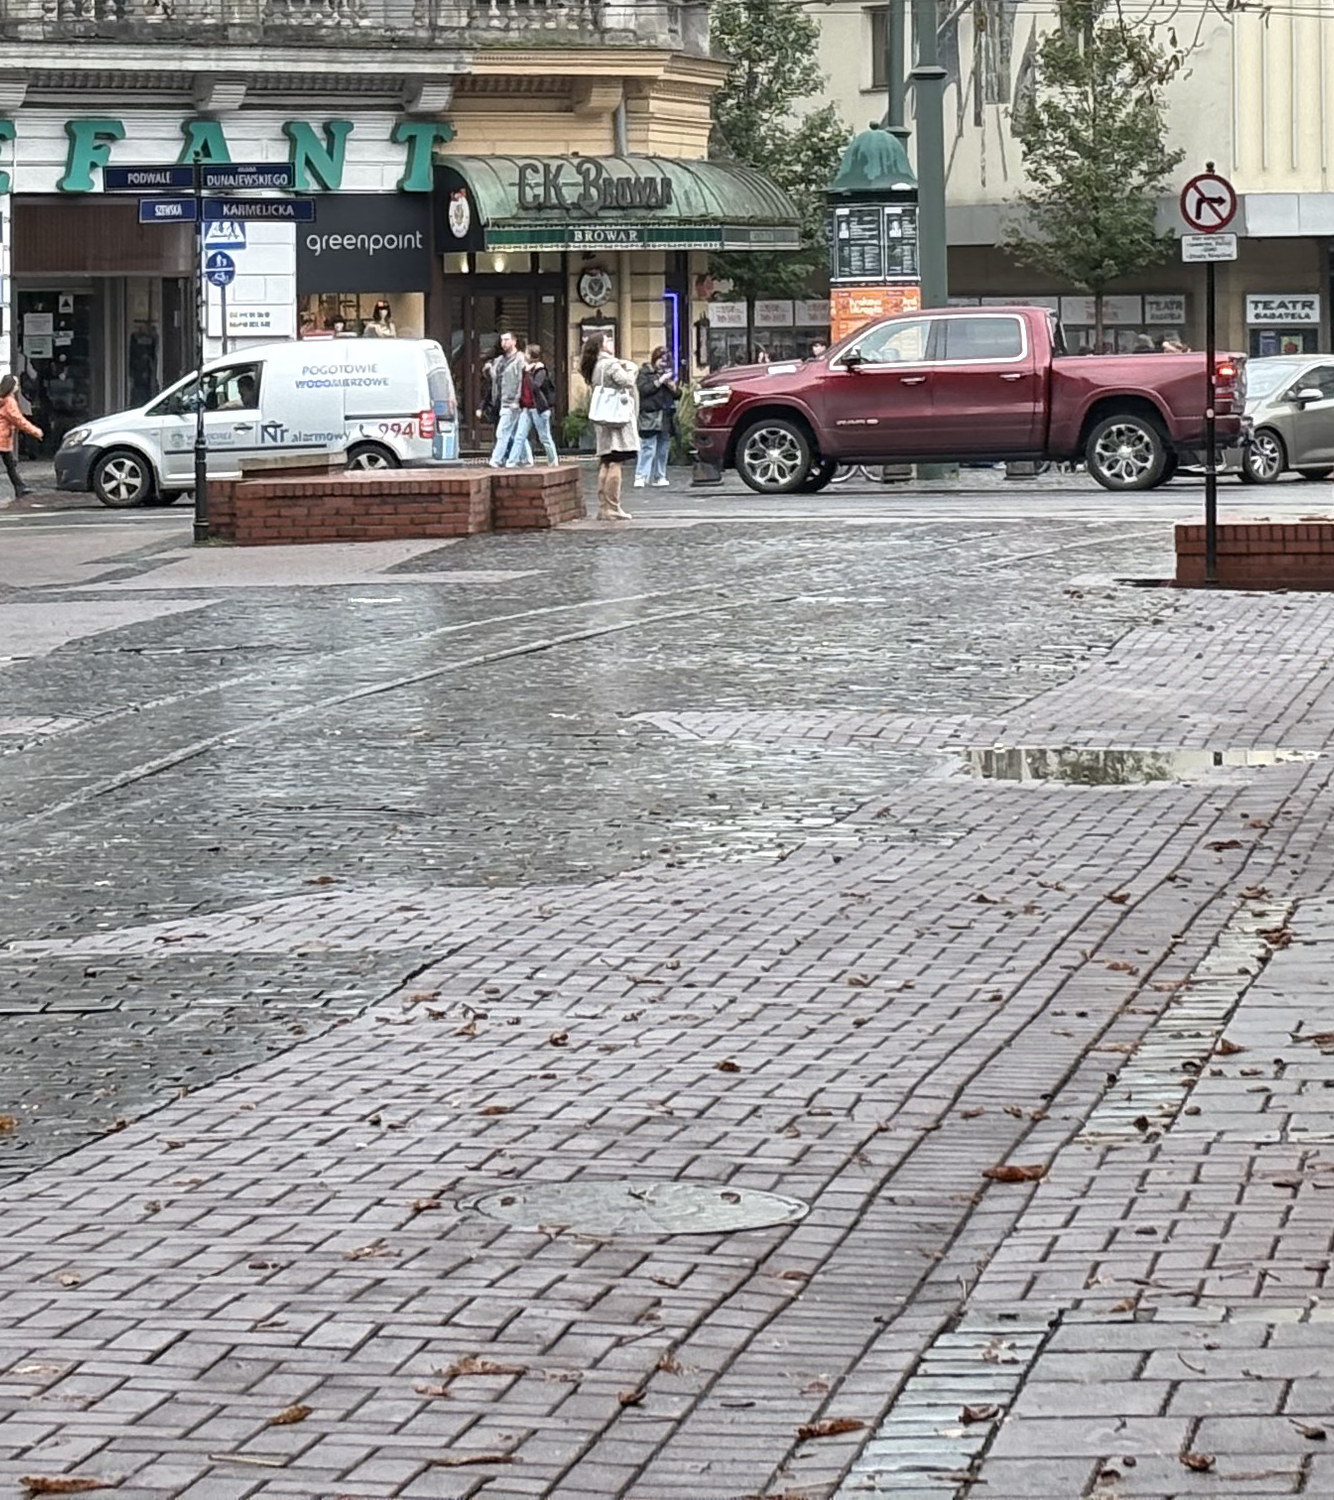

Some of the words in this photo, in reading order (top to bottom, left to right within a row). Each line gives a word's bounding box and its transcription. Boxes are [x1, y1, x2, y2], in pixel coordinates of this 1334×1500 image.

[127, 171, 171, 185] PODWALE
[207, 173, 288, 186] DUNAJEWSKIEGO
[222, 204, 294, 216] KARMELICKA
[573, 230, 640, 242] BROWAR
[306, 230, 423, 256] greenpoint
[1250, 300, 1316, 310] TEATR
[302, 364, 378, 376] POGOTOWIE
[261, 424, 289, 443] Nr
[378, 422, 414, 439] 994
